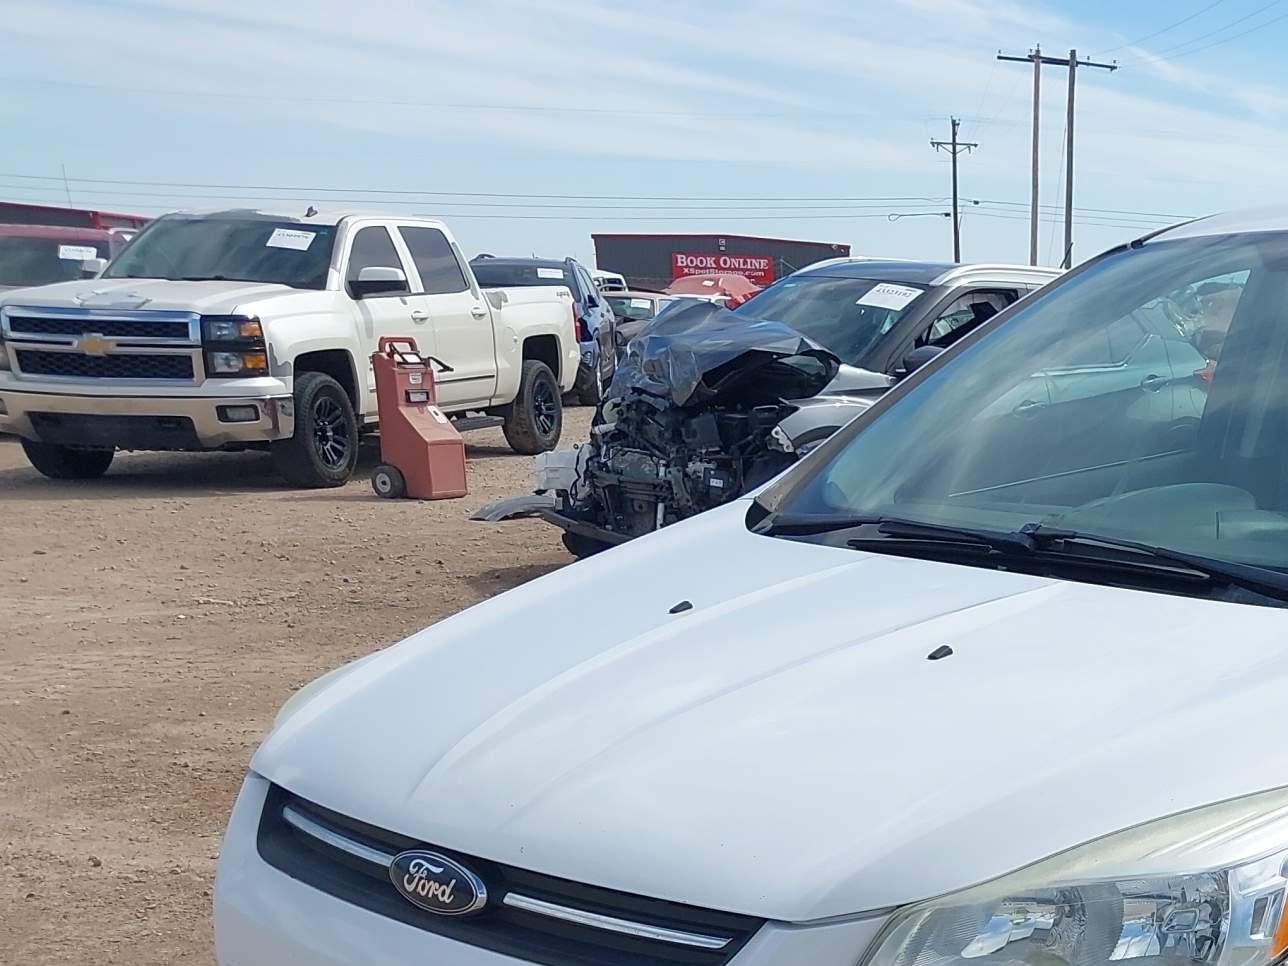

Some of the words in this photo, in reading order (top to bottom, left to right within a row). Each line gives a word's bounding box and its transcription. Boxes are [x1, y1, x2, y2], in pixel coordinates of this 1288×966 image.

[676, 254, 717, 268] BOOK
[720, 256, 768, 270] ONLINE
[403, 858, 457, 904] Ford
